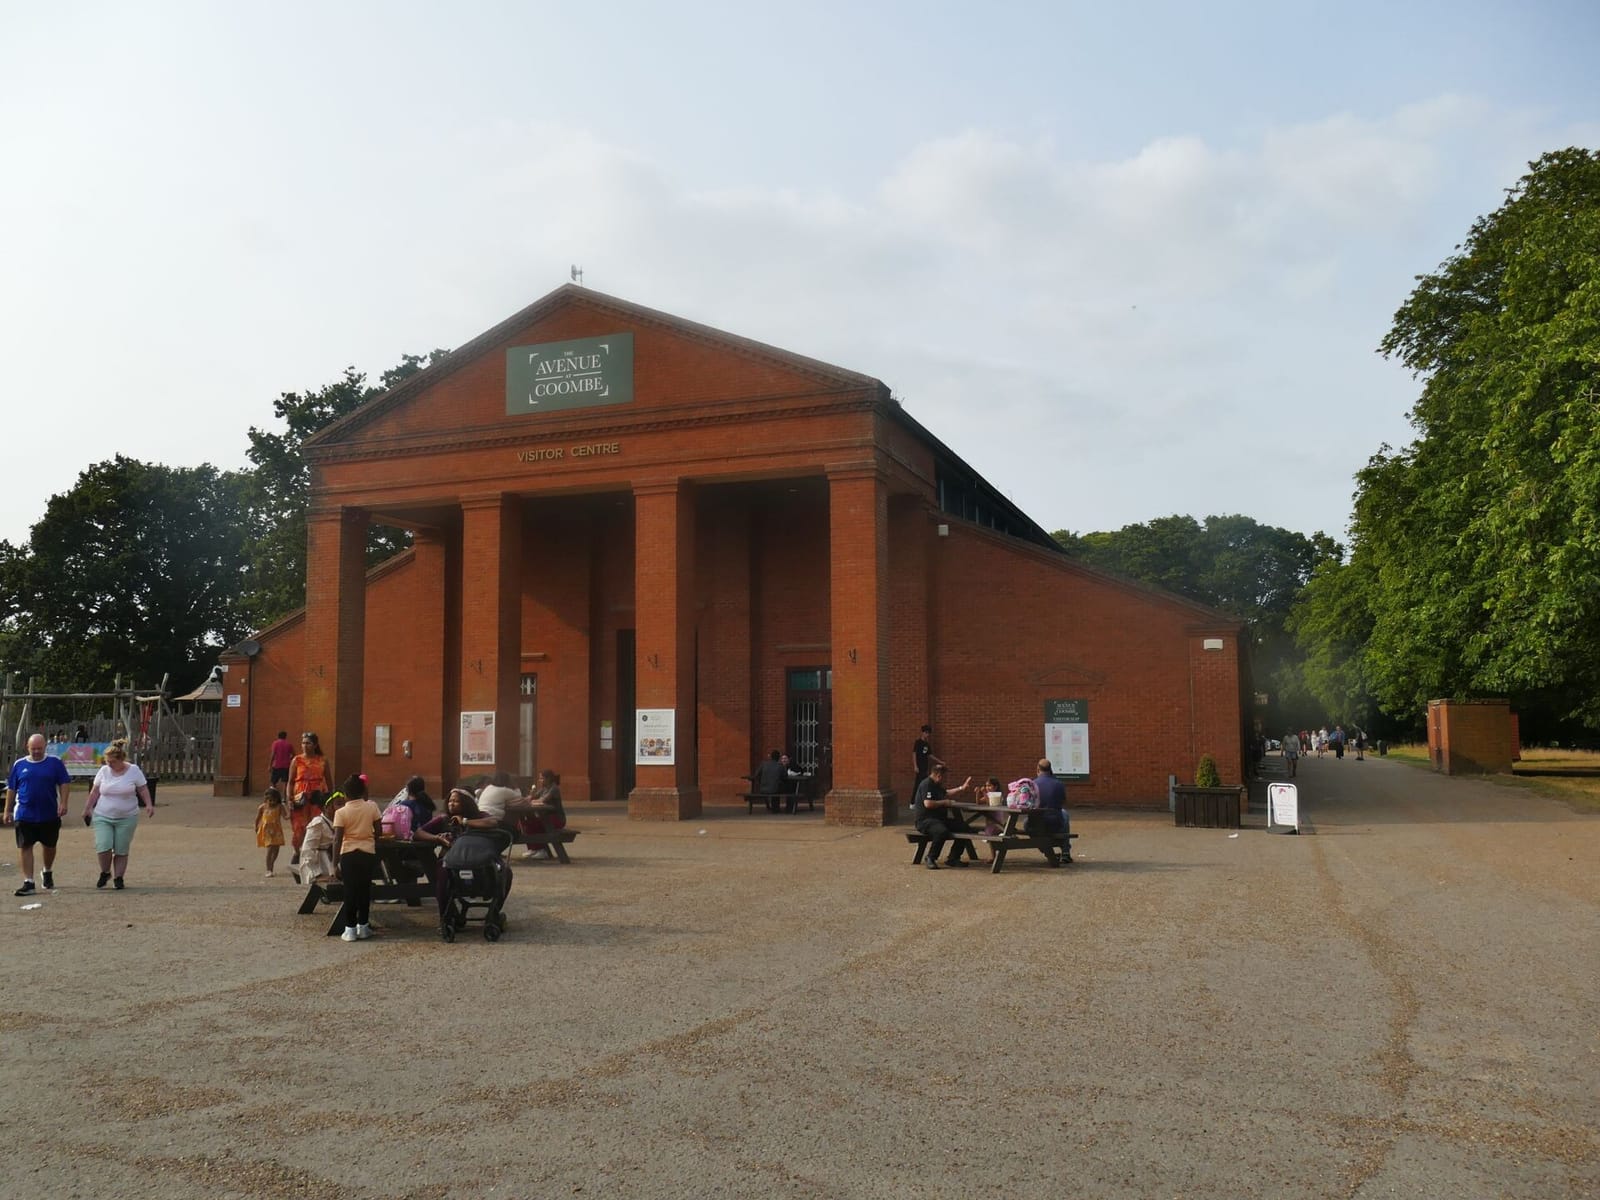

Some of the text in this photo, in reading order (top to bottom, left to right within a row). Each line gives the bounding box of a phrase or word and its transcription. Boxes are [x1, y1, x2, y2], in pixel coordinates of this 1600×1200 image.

[535, 354, 601, 375] AVENUE
[535, 377, 603, 397] COOMBE
[517, 442, 619, 462] VISITOR CENTRE
